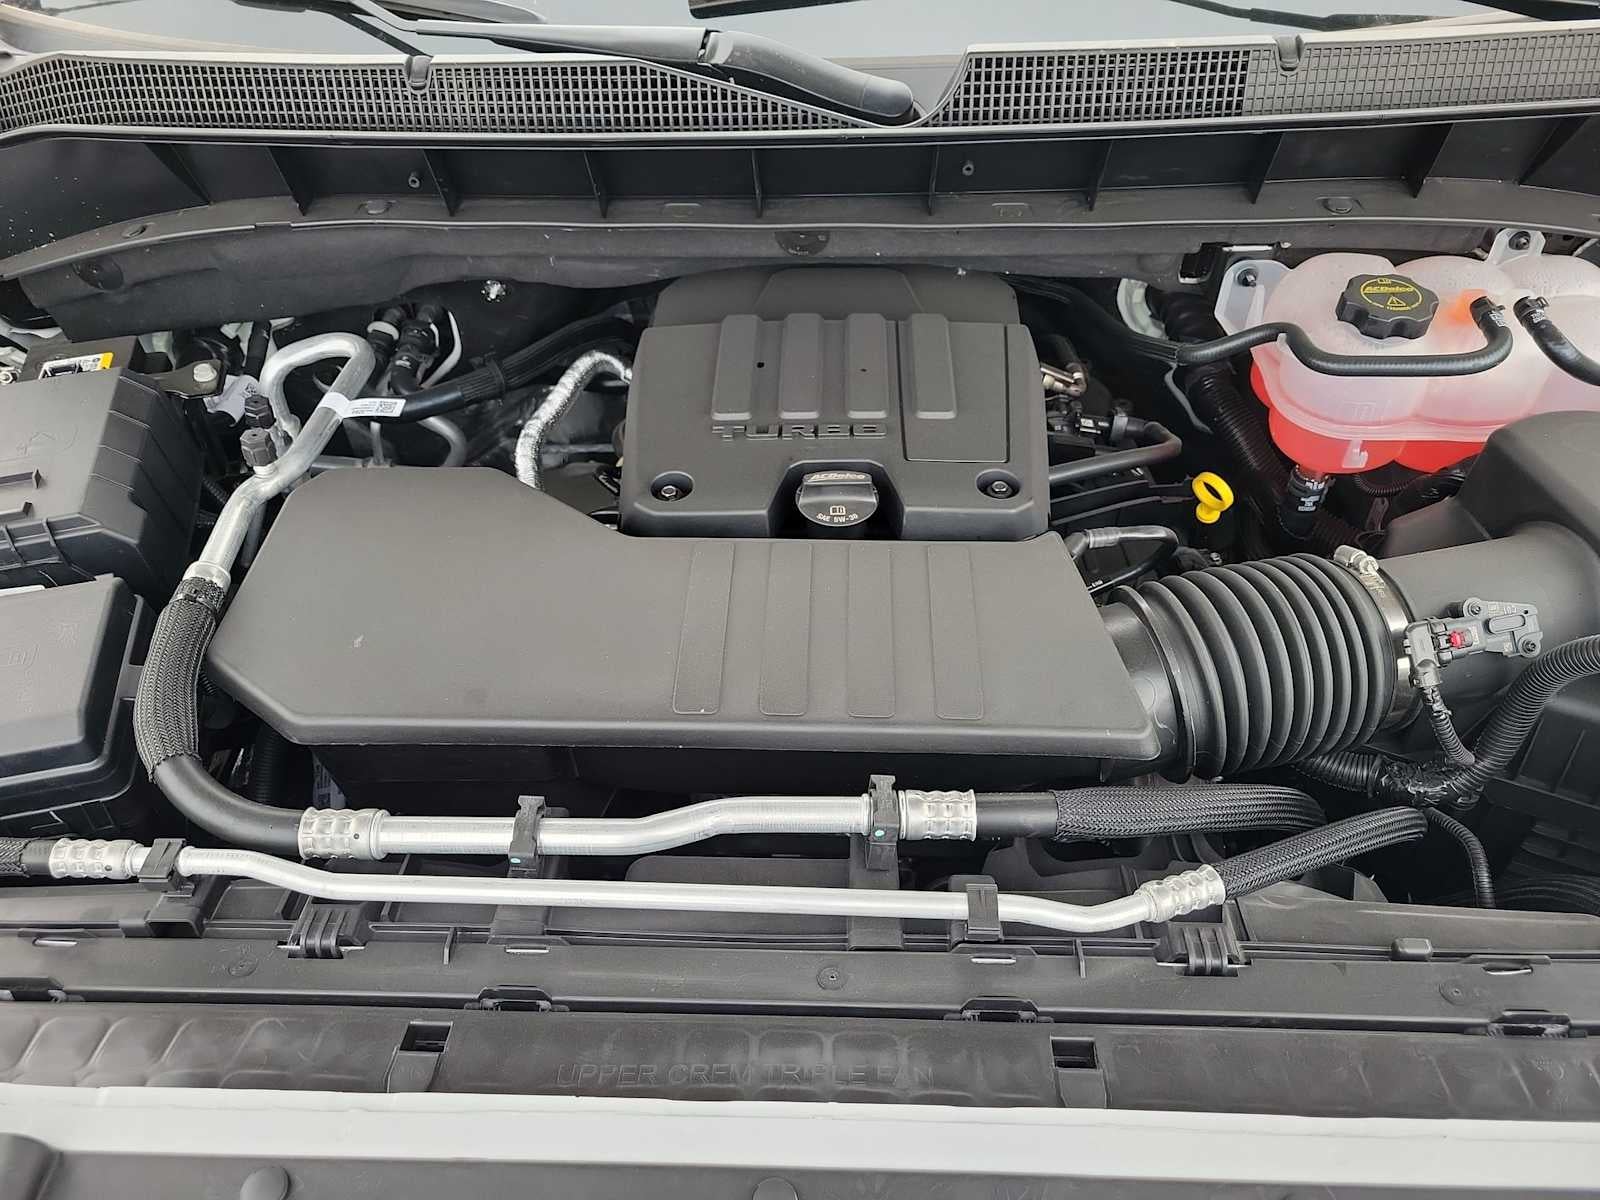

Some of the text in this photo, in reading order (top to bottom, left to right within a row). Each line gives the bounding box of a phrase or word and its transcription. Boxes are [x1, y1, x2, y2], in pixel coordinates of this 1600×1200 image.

[711, 423, 887, 441] TURBO
[816, 512, 831, 522] SAE
[556, 1063, 657, 1088] UPPER
